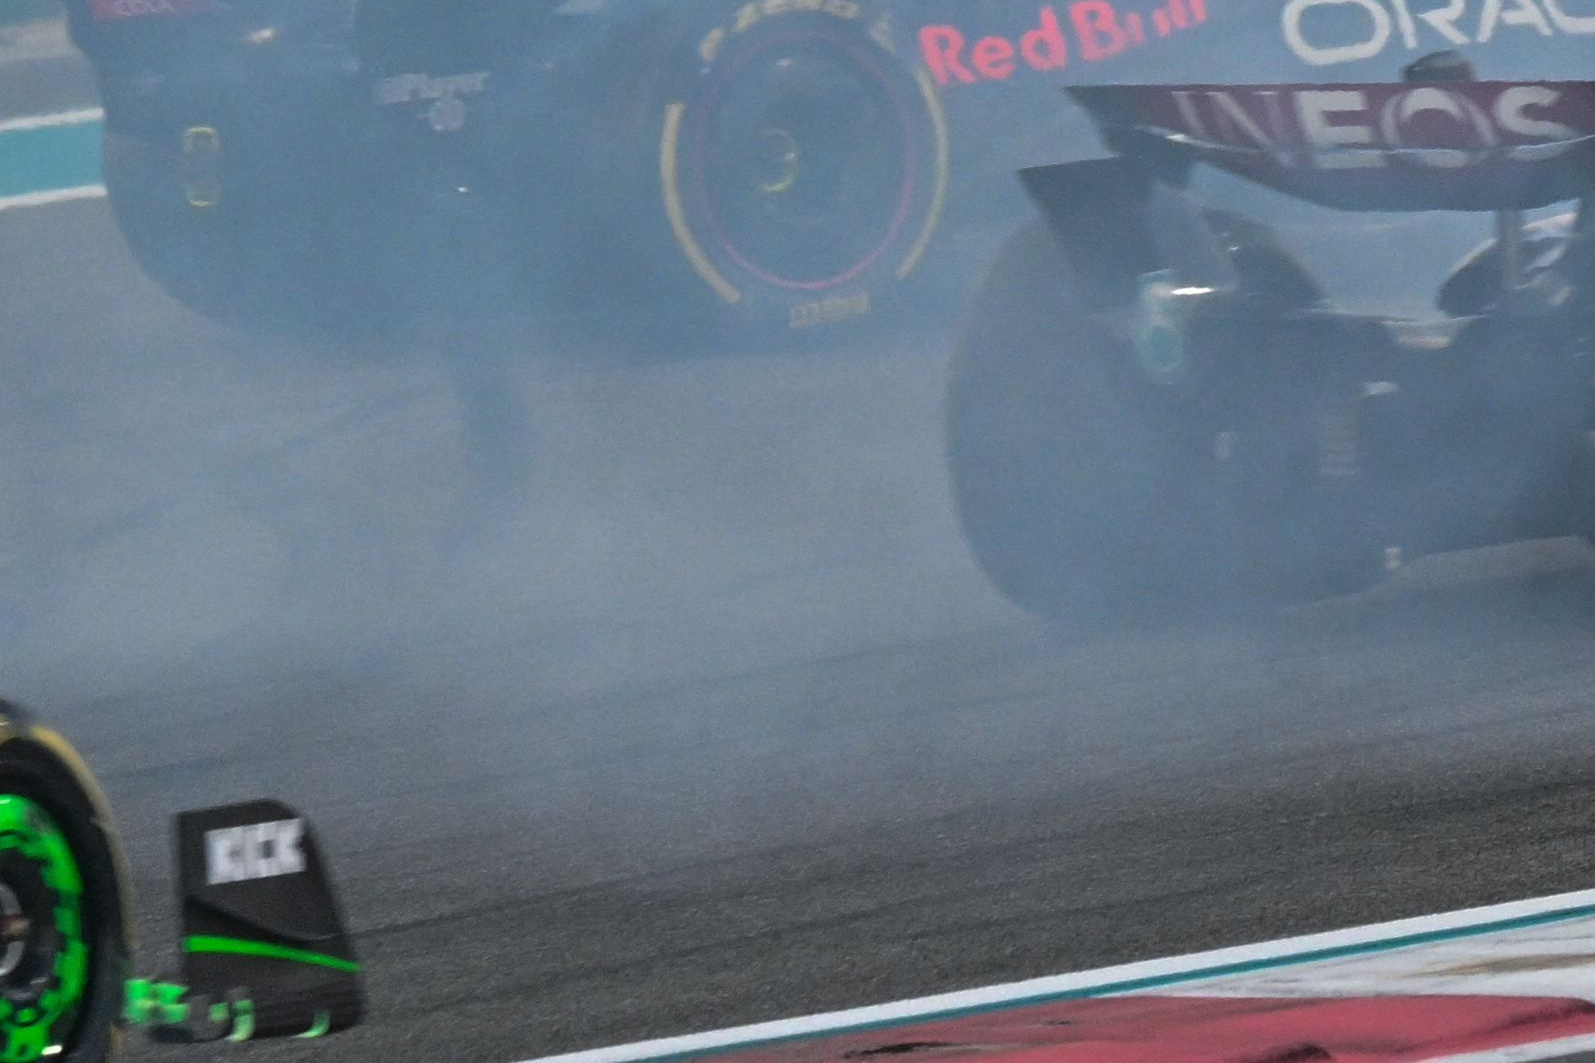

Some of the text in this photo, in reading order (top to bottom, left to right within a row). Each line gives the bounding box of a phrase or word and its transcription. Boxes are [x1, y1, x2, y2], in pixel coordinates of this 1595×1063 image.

[917, 6, 1065, 87] Red
[1170, 85, 1580, 170] INEOS
[204, 817, 305, 886] KICK
